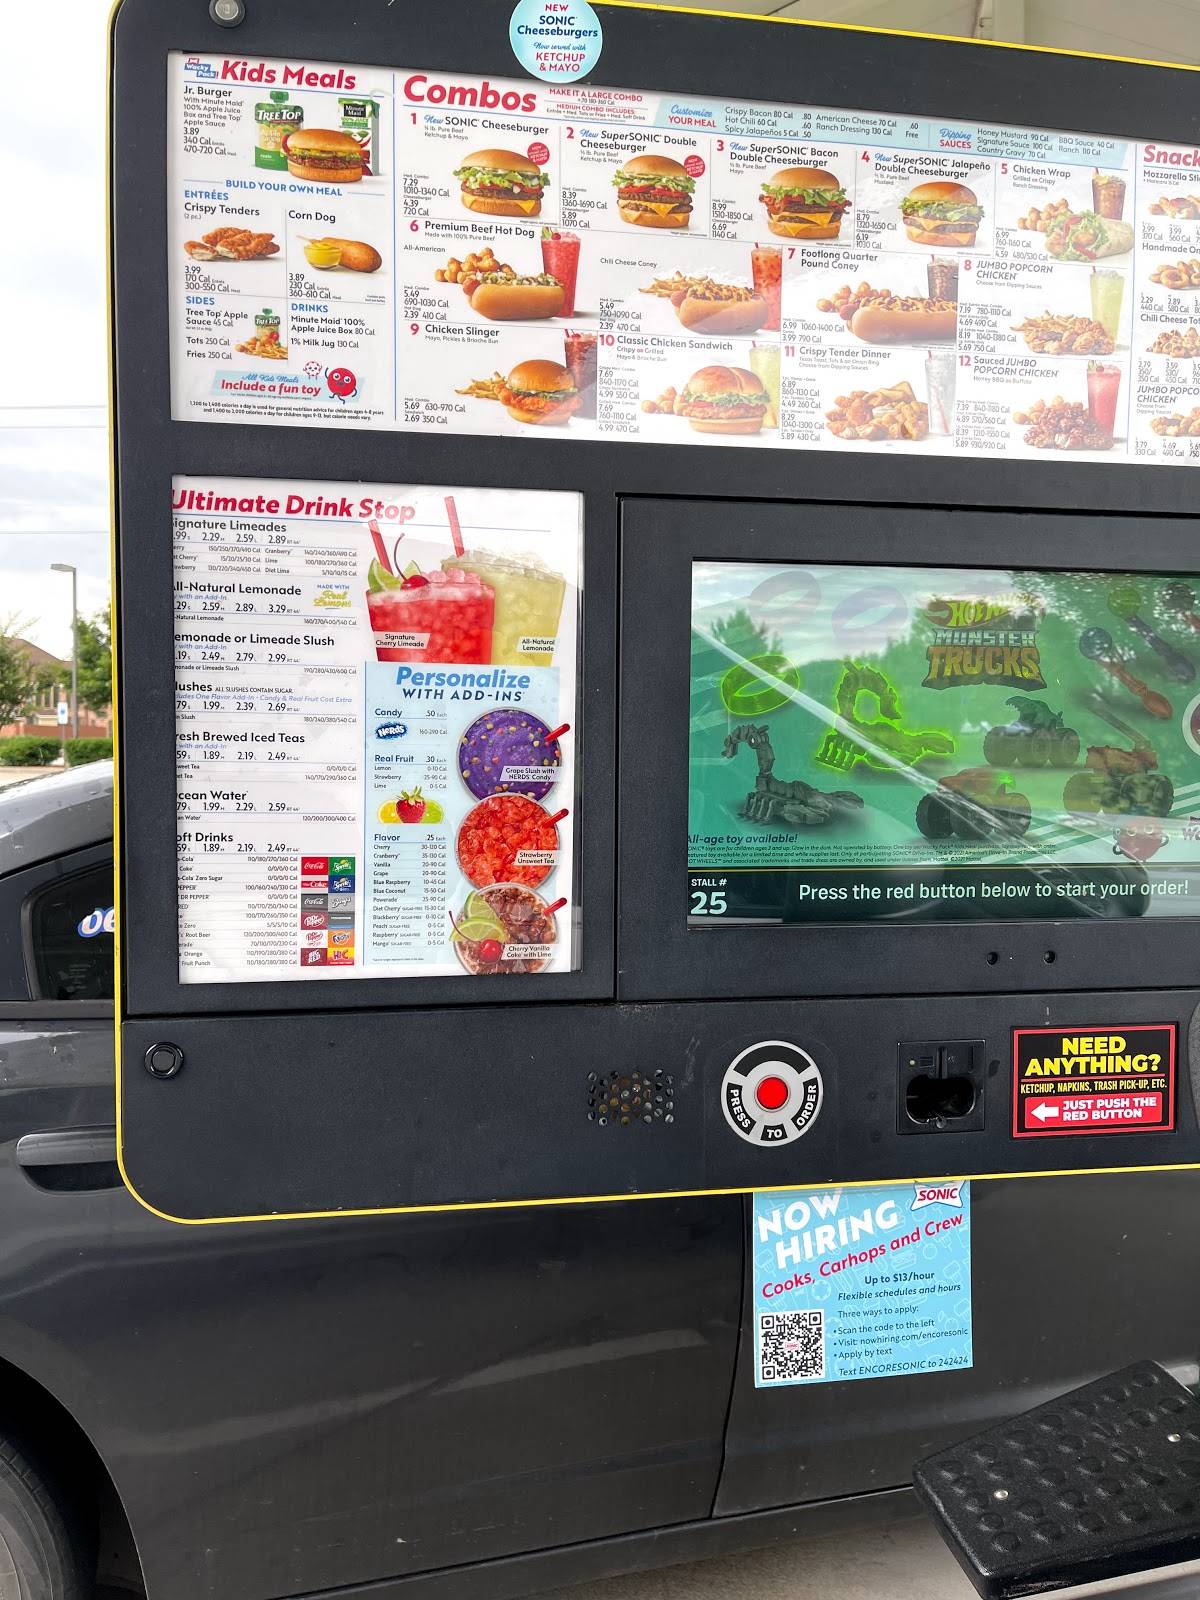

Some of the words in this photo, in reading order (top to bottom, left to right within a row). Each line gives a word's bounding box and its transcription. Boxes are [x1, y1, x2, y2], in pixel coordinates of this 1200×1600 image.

[539, 16, 575, 25] SONIC
[517, 25, 598, 38] Cheeseburgers
[536, 52, 585, 61] KETCHUP
[540, 63, 546, 71] &
[549, 63, 579, 72] MAYO
[221, 60, 276, 84] Kids
[282, 65, 356, 90] Meals
[183, 86, 195, 95] Jr.
[197, 87, 232, 98] Burger
[403, 75, 537, 113] Combos
[550, 88, 571, 96] MAKE
[588, 91, 612, 99] LARGE
[614, 94, 642, 102] COMBO
[671, 104, 712, 118] Customize
[725, 106, 747, 118] Crispy
[749, 108, 772, 117] Bacon
[774, 109, 782, 118] 80
[783, 110, 793, 119] Cal
[411, 113, 417, 124] 1
[424, 115, 443, 126] New
[445, 117, 478, 127] SONIC
[482, 120, 549, 135] Cheeseburger
[669, 115, 693, 125] YOUR
[694, 119, 716, 127] MEAL
[566, 127, 574, 139] 2
[580, 128, 599, 139] New
[664, 135, 697, 146] Double
[580, 139, 646, 153] Cheeseburger
[1001, 164, 1008, 175] 5
[1013, 164, 1046, 176] Chicken
[1048, 167, 1071, 179] Wrap
[1144, 170, 1186, 181] Mozzarella
[225, 179, 256, 190] BUILD
[257, 182, 287, 192] YOUR
[289, 185, 314, 194] OWN
[316, 187, 343, 196] MEAL
[403, 178, 418, 186] 7.29
[184, 189, 229, 201] ENTRÉES
[403, 186, 436, 197] 1010-1340
[438, 189, 449, 197] Cal
[184, 202, 216, 214] Crispy
[219, 204, 260, 216] Tenders
[288, 210, 312, 221] Corn
[315, 213, 336, 224] Dog
[410, 220, 418, 232] 6
[425, 221, 468, 232] Premium
[471, 223, 492, 234] Beef
[495, 225, 512, 235] Hot
[515, 225, 535, 239] Dog
[787, 248, 796, 259] 7
[801, 249, 840, 261] Footlong
[842, 251, 877, 262] Quarter
[801, 259, 829, 268] Pound
[832, 261, 859, 272] Coney
[964, 260, 971, 270] 8
[976, 260, 1008, 271] JUMBO
[1009, 262, 1053, 273] POPCORN
[976, 271, 1016, 281] CHICKEN
[186, 296, 214, 305] SIDES
[291, 303, 328, 313] DRINKS
[410, 323, 419, 335] 9
[425, 324, 463, 336] Chicken
[466, 326, 499, 338] Slinger
[187, 337, 203, 345] Tots
[219, 338, 230, 346] Cal
[599, 334, 614, 346] 10
[617, 335, 648, 346] Classic
[650, 337, 686, 348] Chicken
[689, 340, 732, 350] Sandwich
[221, 380, 265, 393] Include
[268, 384, 276, 393] a
[278, 382, 299, 395] fun
[302, 384, 321, 396] toy
[172, 489, 279, 514] Ultimate
[285, 495, 353, 517] Drink
[359, 498, 415, 524] Stop
[230, 520, 287, 533] Limeades
[202, 532, 221, 542] 2.29
[239, 584, 301, 595] Lemonade
[927, 646, 1042, 680] TRUCKS
[396, 666, 530, 689] Personalize
[403, 689, 444, 700] WITH
[451, 690, 522, 701] ADD-INS
[375, 754, 393, 762] Real
[395, 755, 414, 763] Fruit
[691, 878, 717, 887] STALL
[719, 878, 727, 886] #
[799, 884, 847, 900] Press
[852, 884, 881, 899] the
[886, 883, 914, 899] red
[919, 883, 975, 898] button
[981, 882, 1031, 898] below
[1035, 883, 1051, 897] to
[1056, 882, 1095, 896] start
[1100, 884, 1136, 899] your
[1140, 880, 1188, 895] order!
[690, 891, 727, 915] 25
[1062, 1036, 1126, 1056] NEED
[1025, 1054, 1161, 1076] ANYTHING?
[1020, 1084, 1055, 1094] KETCHUP,
[1058, 1082, 1091, 1093] NAPKINS,
[1094, 1081, 1117, 1091] TRASH
[1120, 1080, 1149, 1090] PICK-UP,
[1151, 1079, 1167, 1088] ETC.
[730, 1089, 751, 1128] PRESS
[797, 1085, 816, 1126] ORDER
[1063, 1100, 1094, 1111] JUST
[1096, 1098, 1129, 1108] PUSH
[1132, 1097, 1157, 1107] THE
[1063, 1111, 1088, 1121] RED
[1091, 1108, 1142, 1120] BUTTON
[767, 1129, 782, 1138] TO
[917, 1187, 959, 1201] SONIC
[758, 1187, 844, 1243] NOW
[776, 1200, 898, 1270] HIRING
[762, 1272, 816, 1298] Cooks,
[819, 1245, 886, 1276] Carhops
[890, 1227, 921, 1250] and
[924, 1214, 963, 1236] Crew
[864, 1276, 878, 1286] Up
[881, 1275, 890, 1283] to
[893, 1272, 935, 1283] $13/hour
[838, 1291, 872, 1301] Flexible
[875, 1288, 917, 1298] schedules
[919, 1286, 935, 1294] and
[937, 1283, 961, 1292] hours
[860, 1328, 968, 1345] nowhiring.com/encoresonic
[839, 1367, 857, 1376] Text
[859, 1361, 926, 1374] ENCORESONIC
[928, 1359, 937, 1367] to
[939, 1356, 968, 1367] 242424
